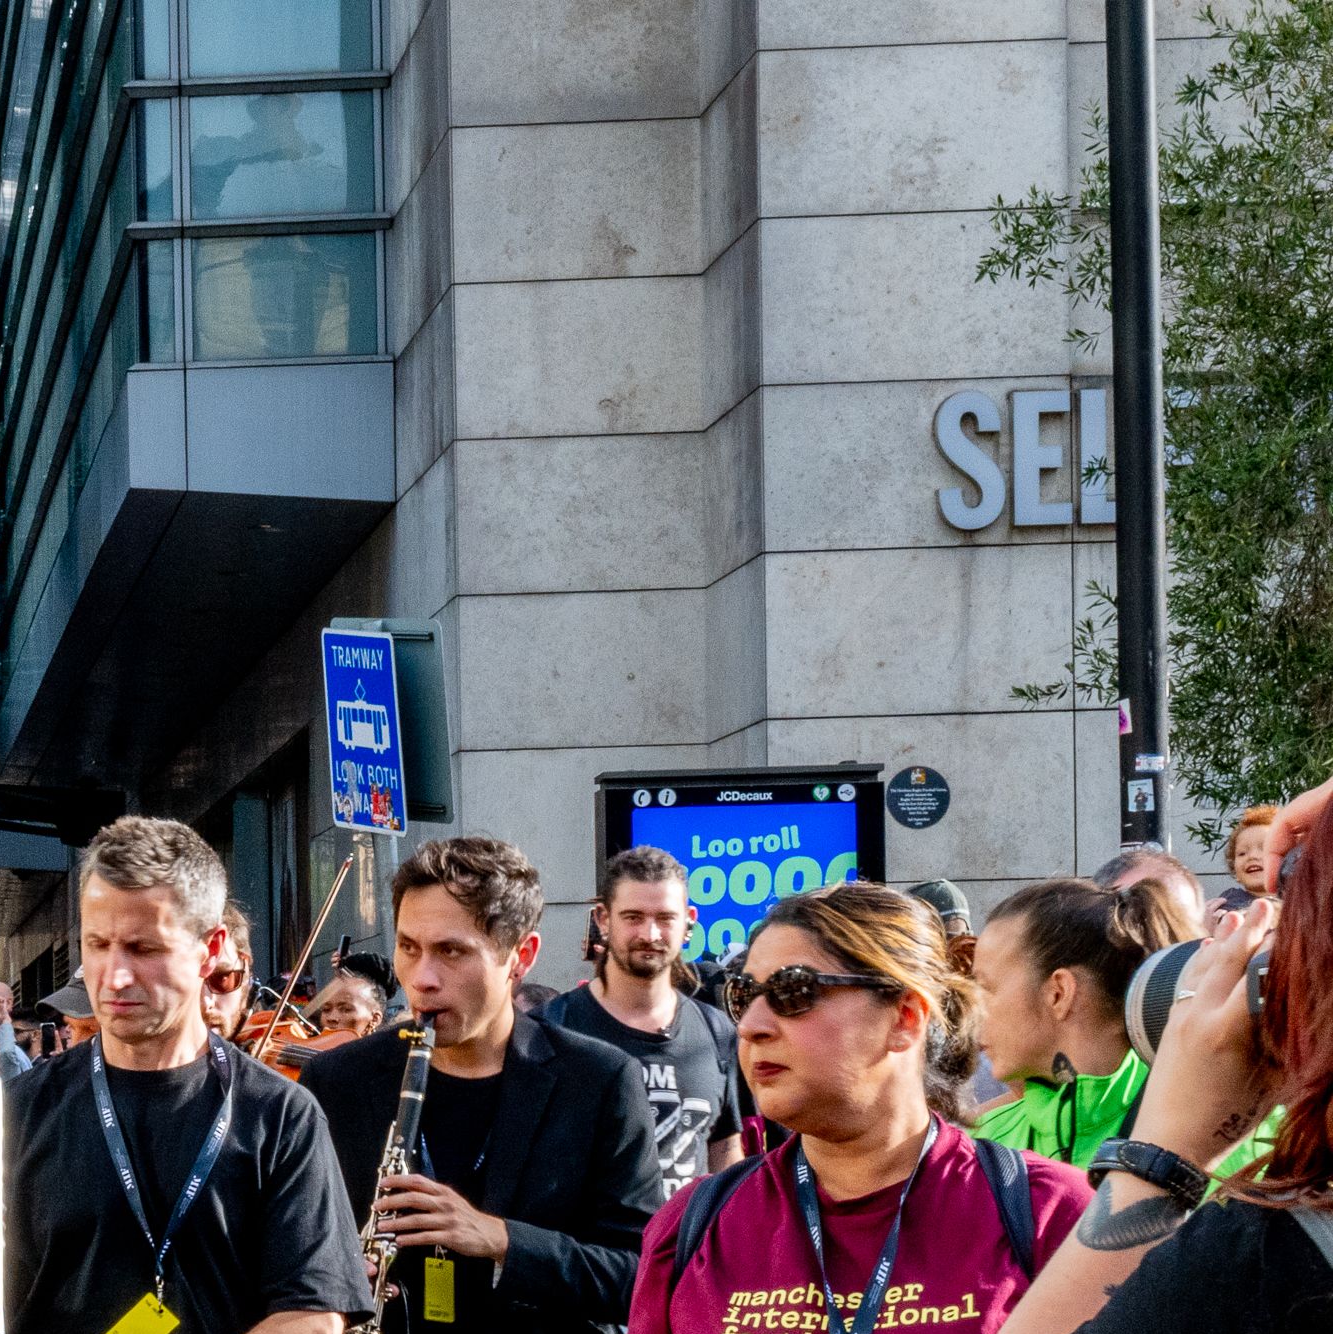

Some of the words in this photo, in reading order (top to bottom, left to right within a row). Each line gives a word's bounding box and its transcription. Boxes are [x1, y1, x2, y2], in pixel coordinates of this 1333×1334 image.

[331, 645, 384, 671] TRAMWAY
[368, 765, 398, 790] BOTH
[717, 791, 773, 802] JCDecaux
[692, 835, 744, 859] Loo
[749, 825, 801, 854] roll
[874, 1257, 891, 1287] MIF
[729, 1283, 924, 1310] mancheser
